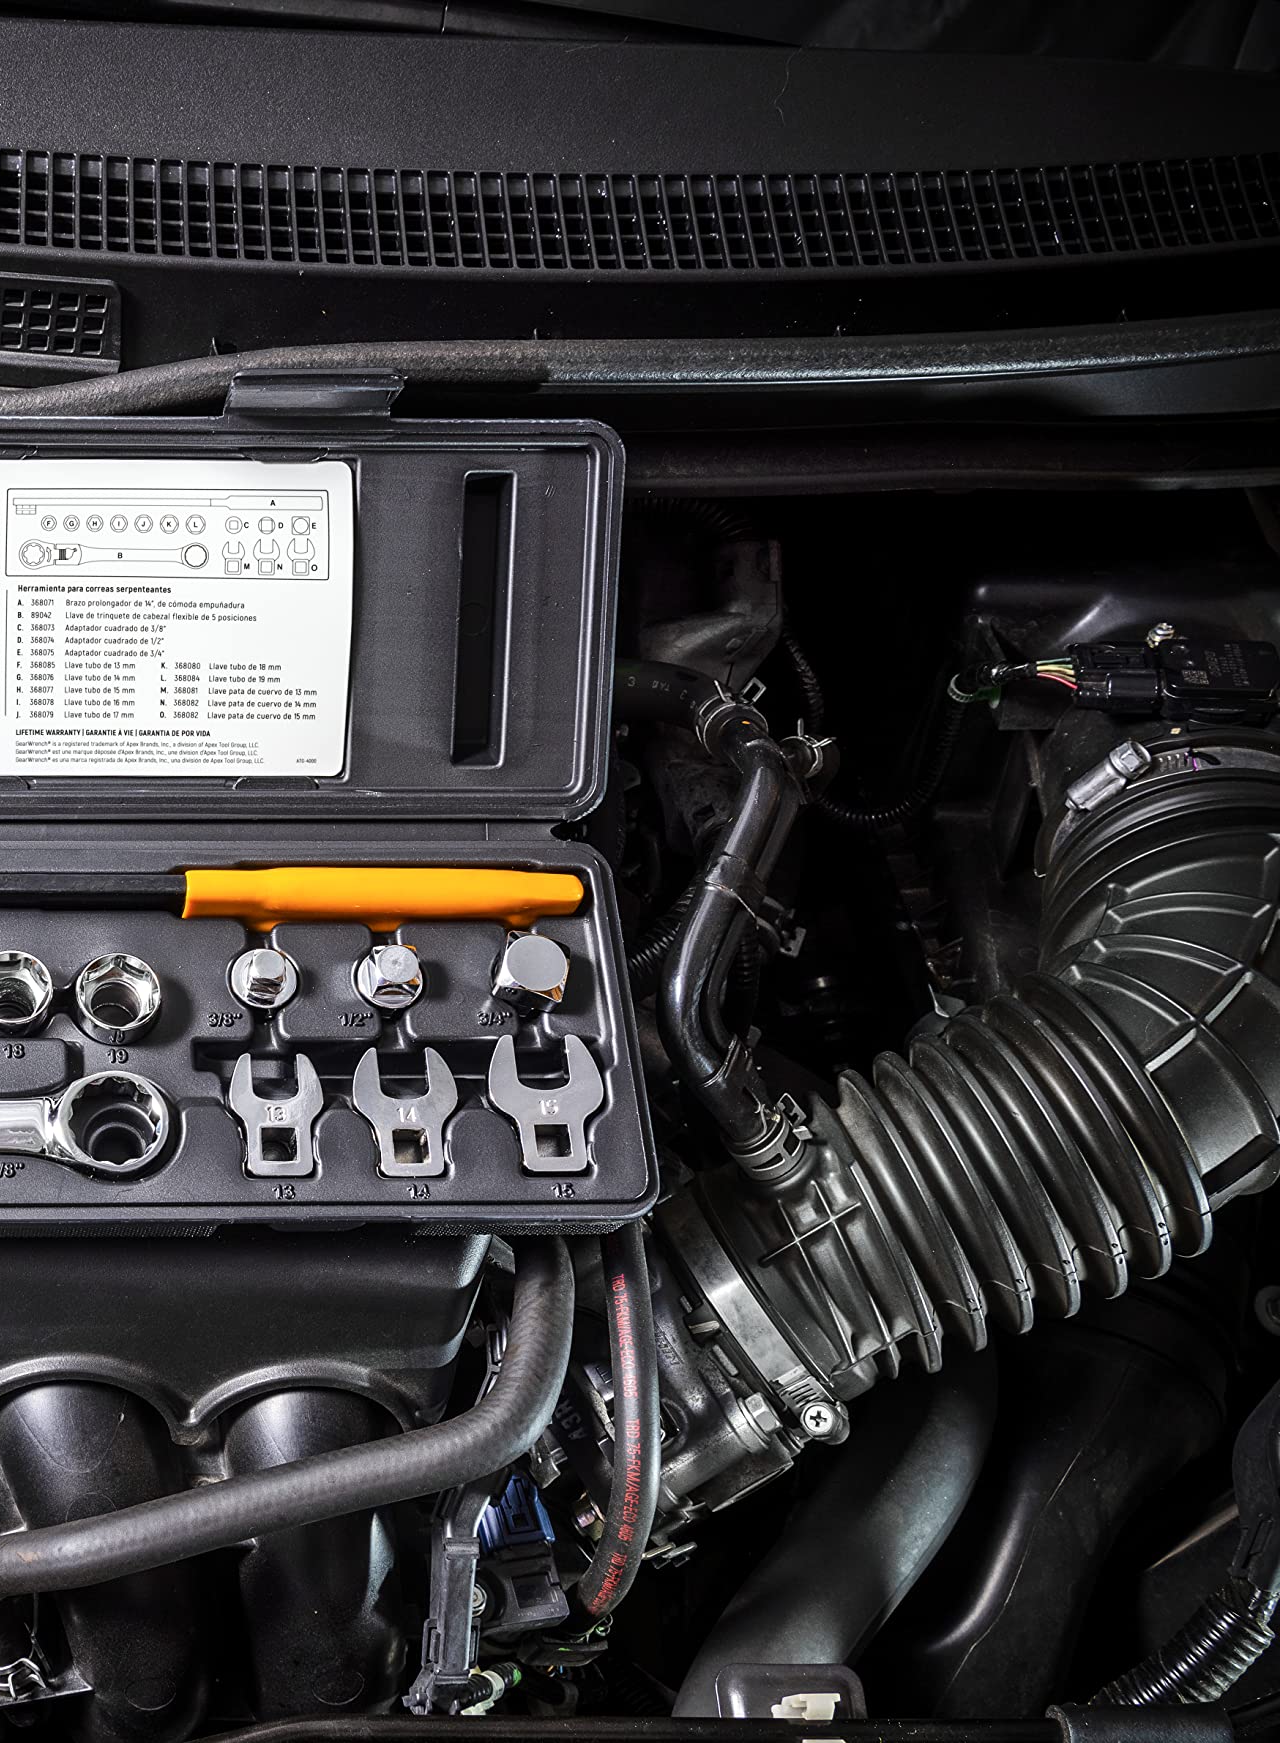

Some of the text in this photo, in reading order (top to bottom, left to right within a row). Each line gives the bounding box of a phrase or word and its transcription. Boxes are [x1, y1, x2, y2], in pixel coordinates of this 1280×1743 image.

[18, 584, 66, 592] Herramienta
[67, 586, 84, 594] para
[116, 586, 172, 594] serpenteantes
[88, 600, 132, 608] prolongador
[157, 600, 166, 608] de
[96, 612, 130, 620] trinquete
[132, 612, 141, 620] de
[172, 612, 199, 620] flexible
[218, 614, 257, 622] posiciones
[3, 1044, 26, 1059] 18
[106, 1048, 129, 1064] 19
[265, 1105, 287, 1123] 13
[396, 1106, 417, 1123] 14
[538, 1099, 559, 1116] 15
[272, 1184, 296, 1200] 13
[407, 1184, 431, 1200] 14
[552, 1183, 575, 1199] 15
[611, 1273, 626, 1292] TRD
[626, 1419, 641, 1439] TRD
